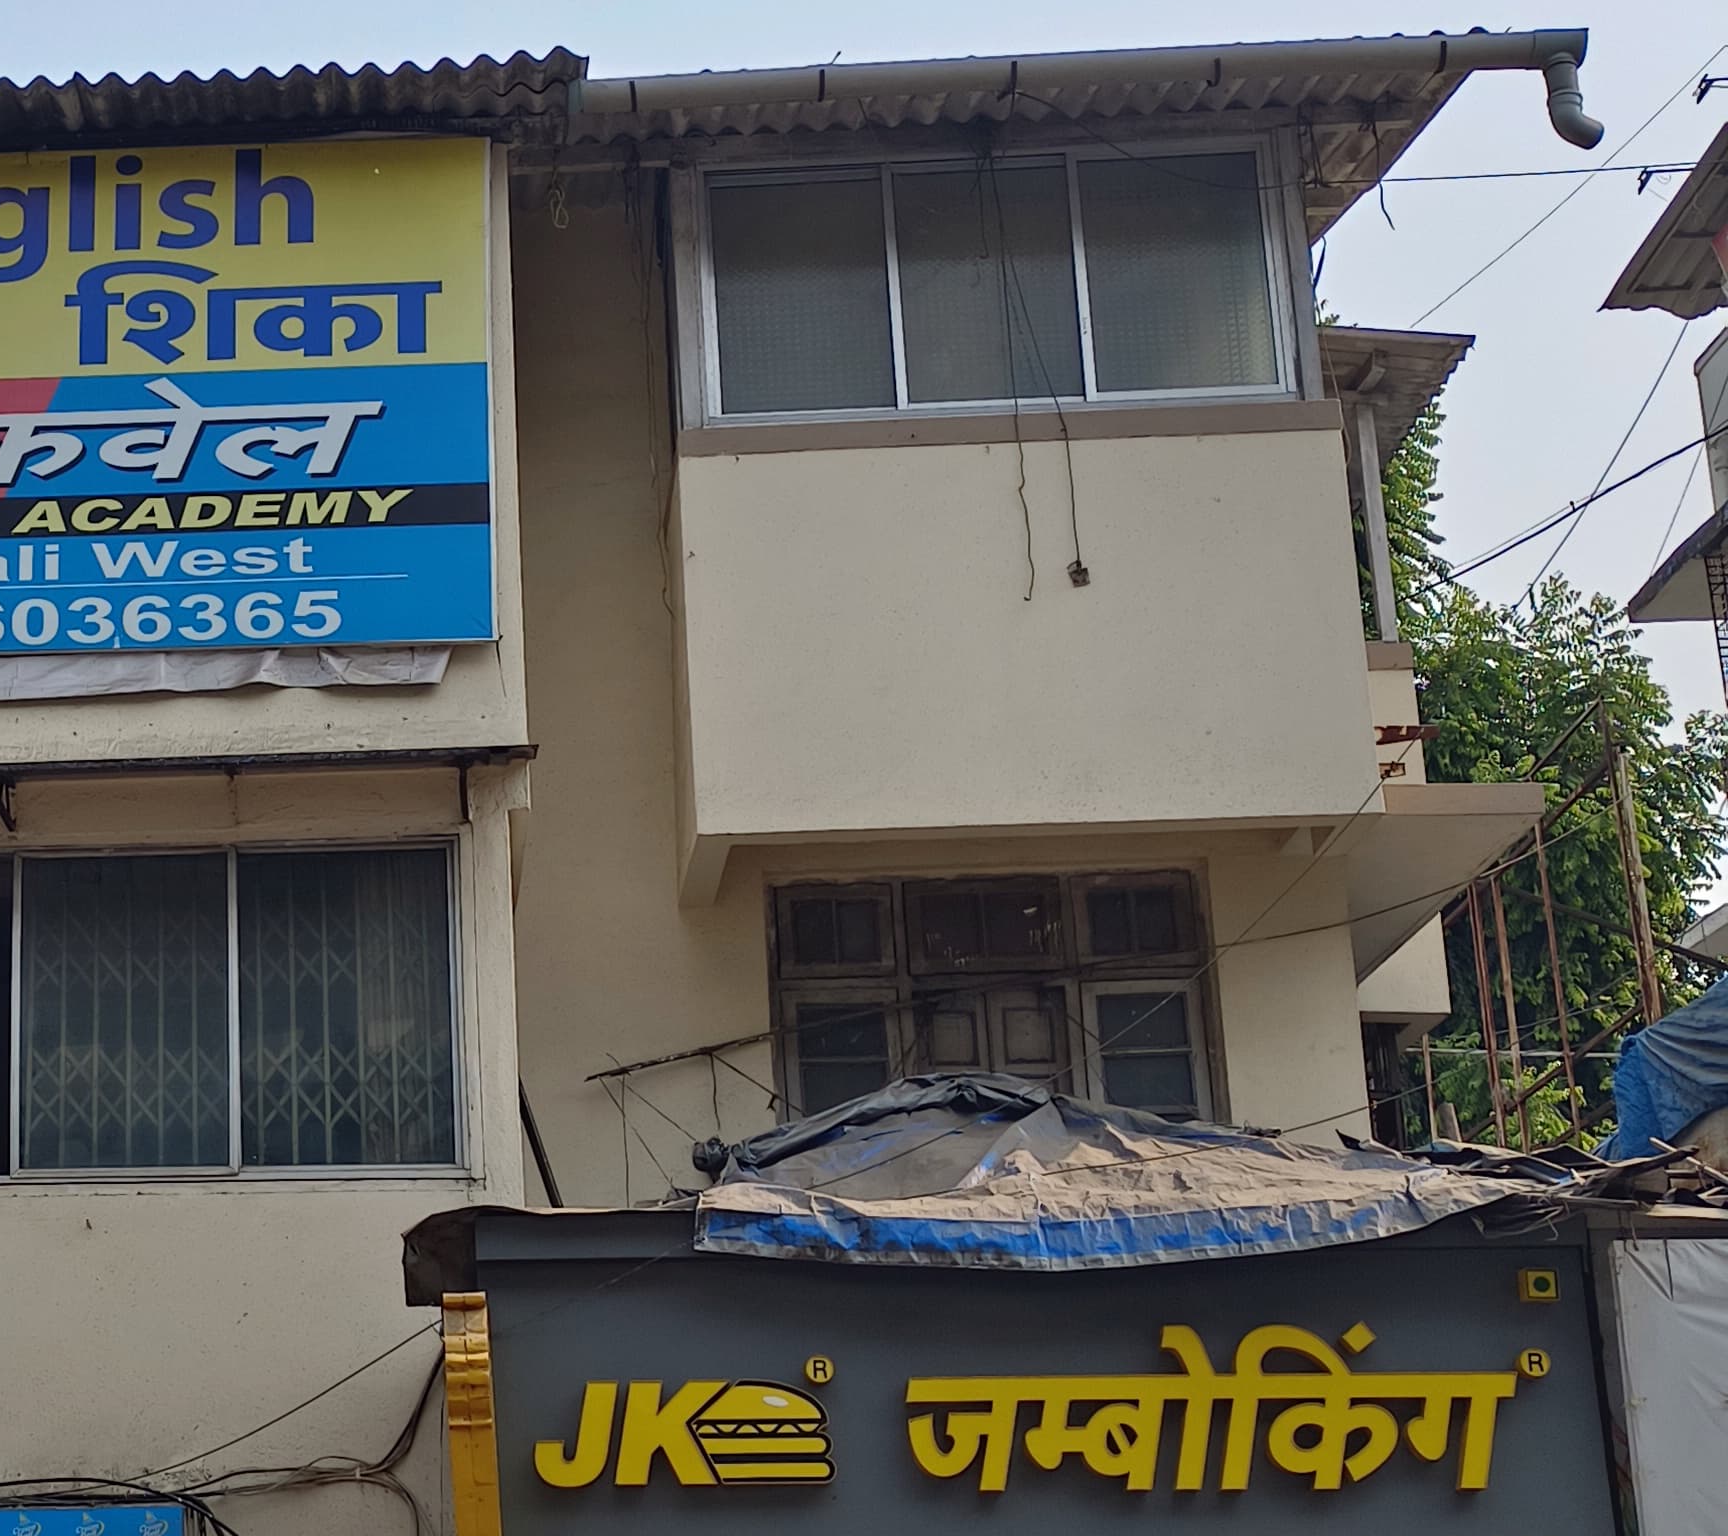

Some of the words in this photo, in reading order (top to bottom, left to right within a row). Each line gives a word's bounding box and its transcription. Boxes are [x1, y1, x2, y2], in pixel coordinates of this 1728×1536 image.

[63, 259, 443, 367] शिका
[10, 486, 415, 537] ACADEMY
[90, 536, 314, 580] West
[533, 1379, 731, 1487] JK
[905, 1322, 1519, 1493] जम्बोकिंग
